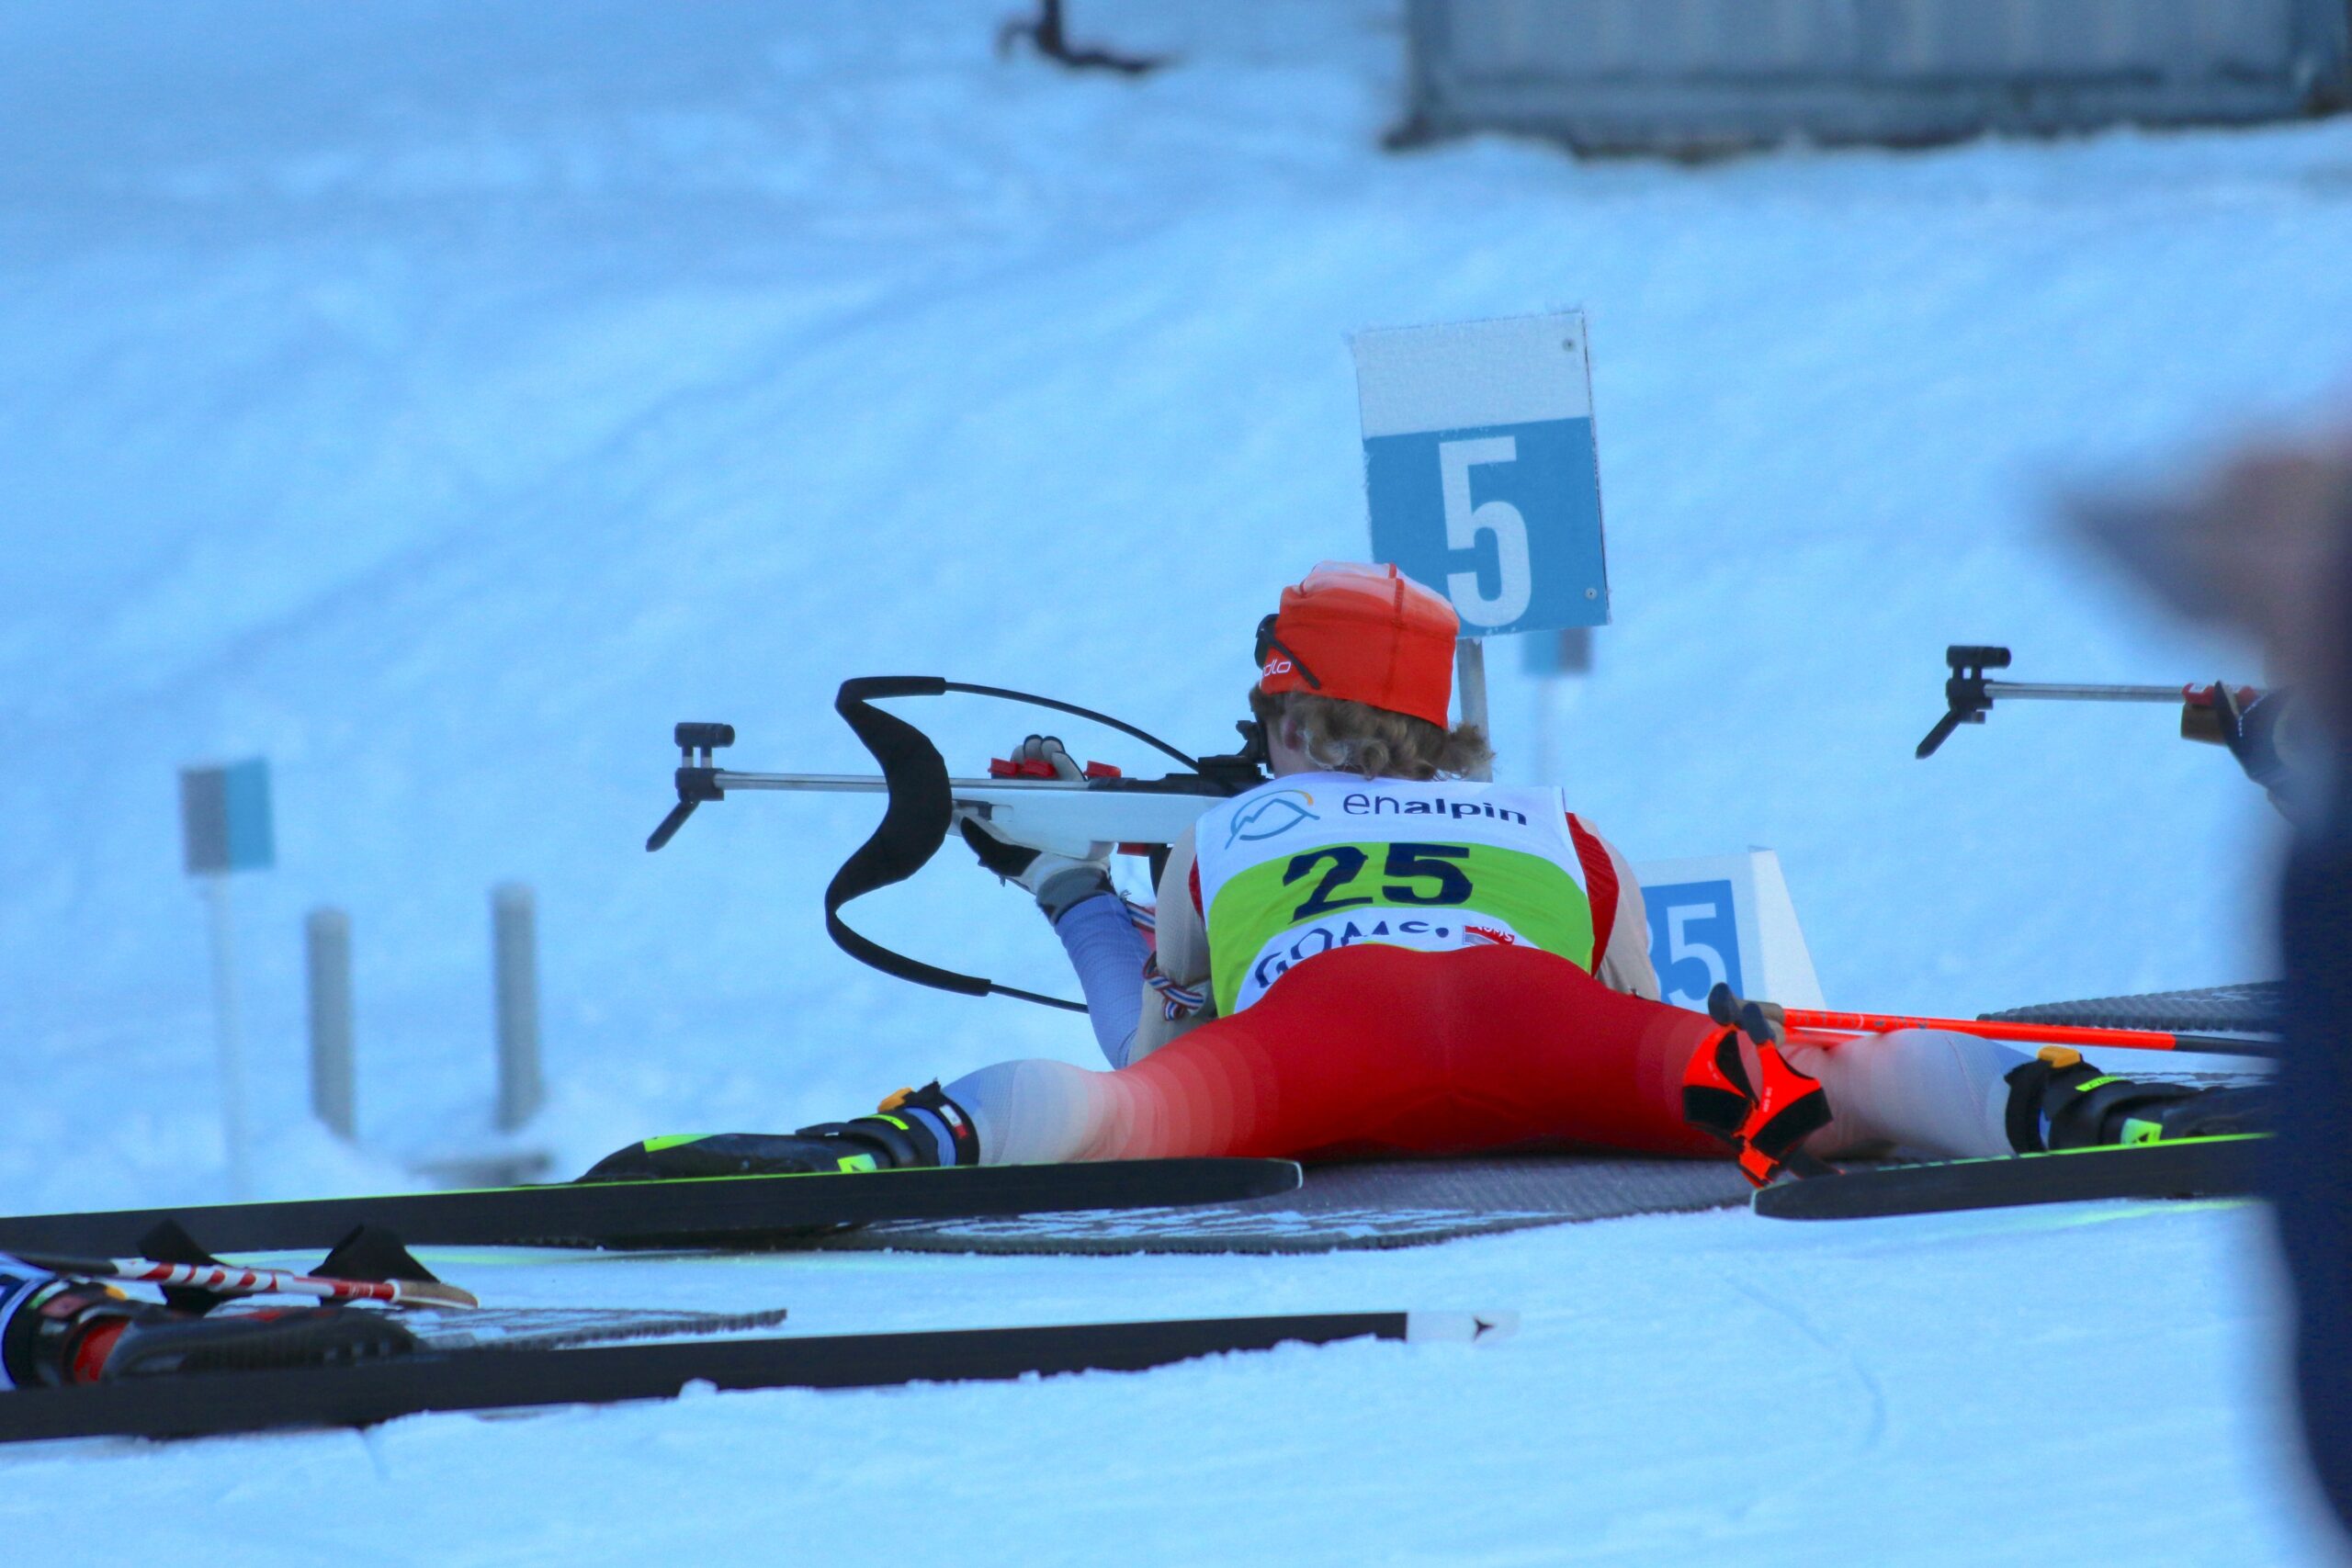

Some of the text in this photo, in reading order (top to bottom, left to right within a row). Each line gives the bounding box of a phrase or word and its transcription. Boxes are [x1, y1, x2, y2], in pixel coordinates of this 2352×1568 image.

[1438, 435, 1532, 627] 5
[1262, 658, 1292, 677] dlo
[1342, 794, 1528, 826] enalpin
[1282, 842, 1474, 925] 25
